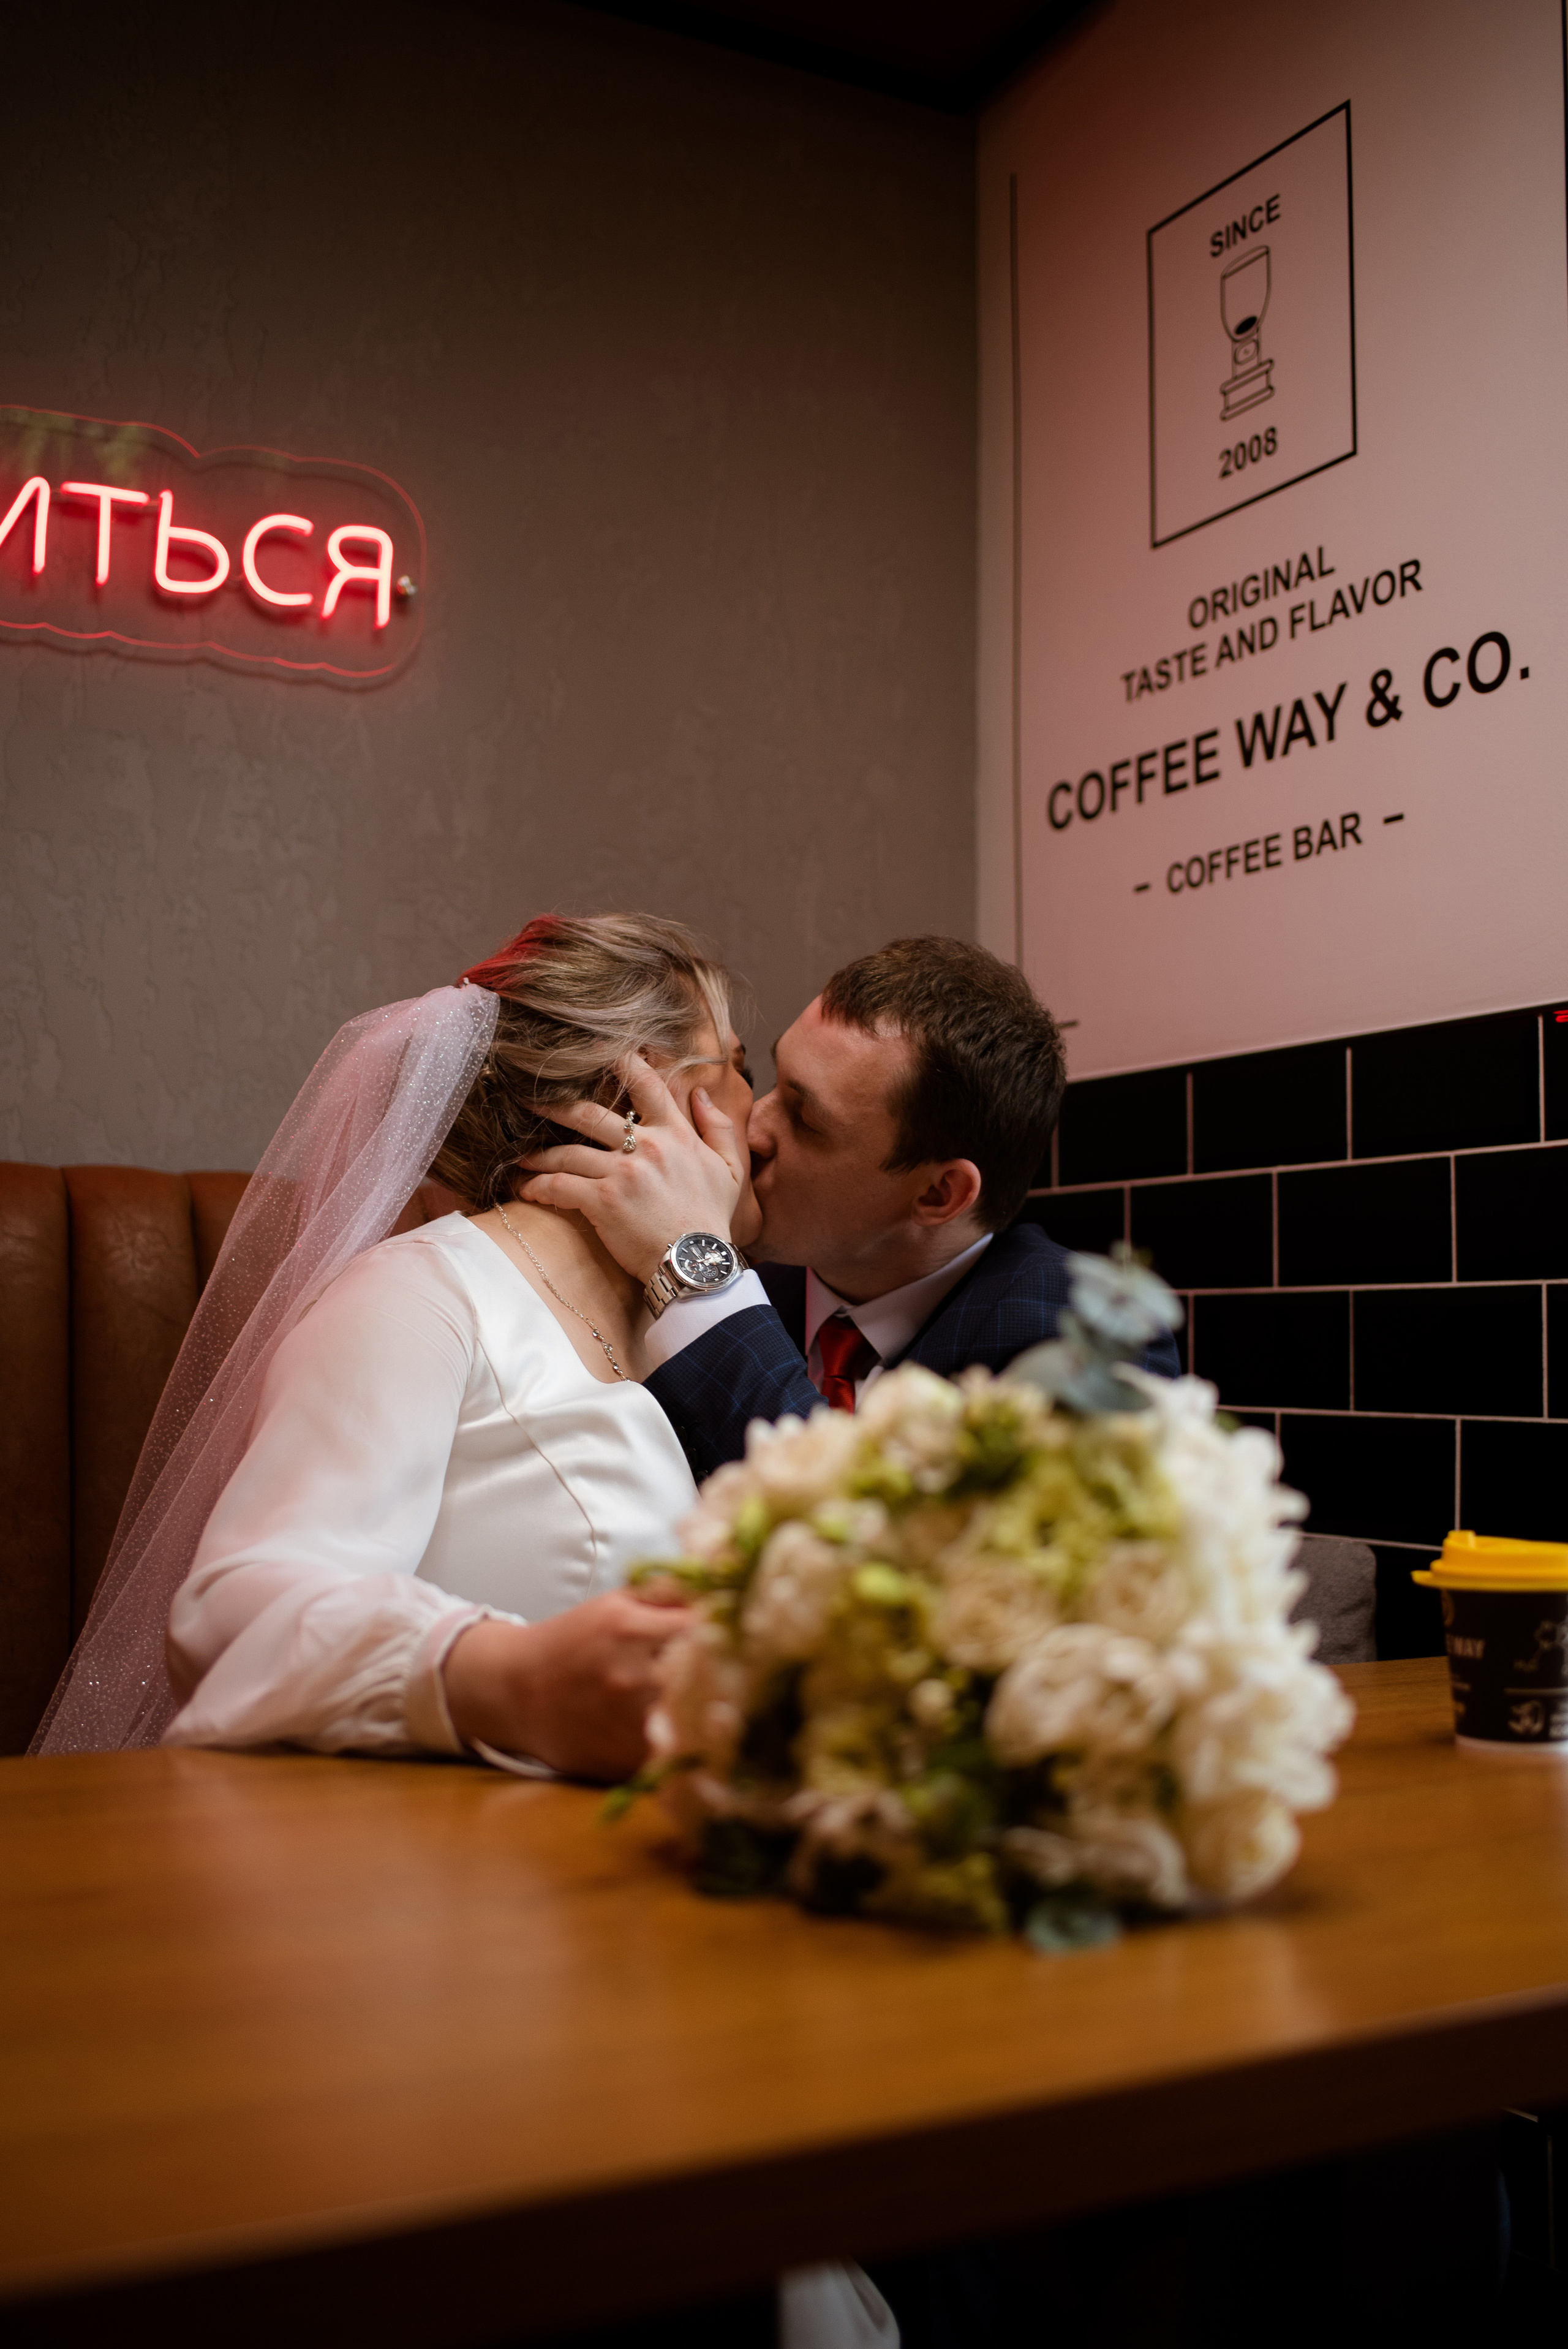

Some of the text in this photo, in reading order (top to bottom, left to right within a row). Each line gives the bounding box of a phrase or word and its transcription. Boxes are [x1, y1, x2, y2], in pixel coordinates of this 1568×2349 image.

[1209, 194, 1281, 258] SINCE
[1219, 426, 1278, 480] 2008
[1188, 545, 1336, 630] ORIGINAL
[1120, 558, 1423, 703] TASTE AND FLAVOR
[1047, 630, 1531, 832] COFFEE WAY & CO.
[1166, 832, 1284, 895] COFFEE
[1292, 811, 1363, 862] BAR
